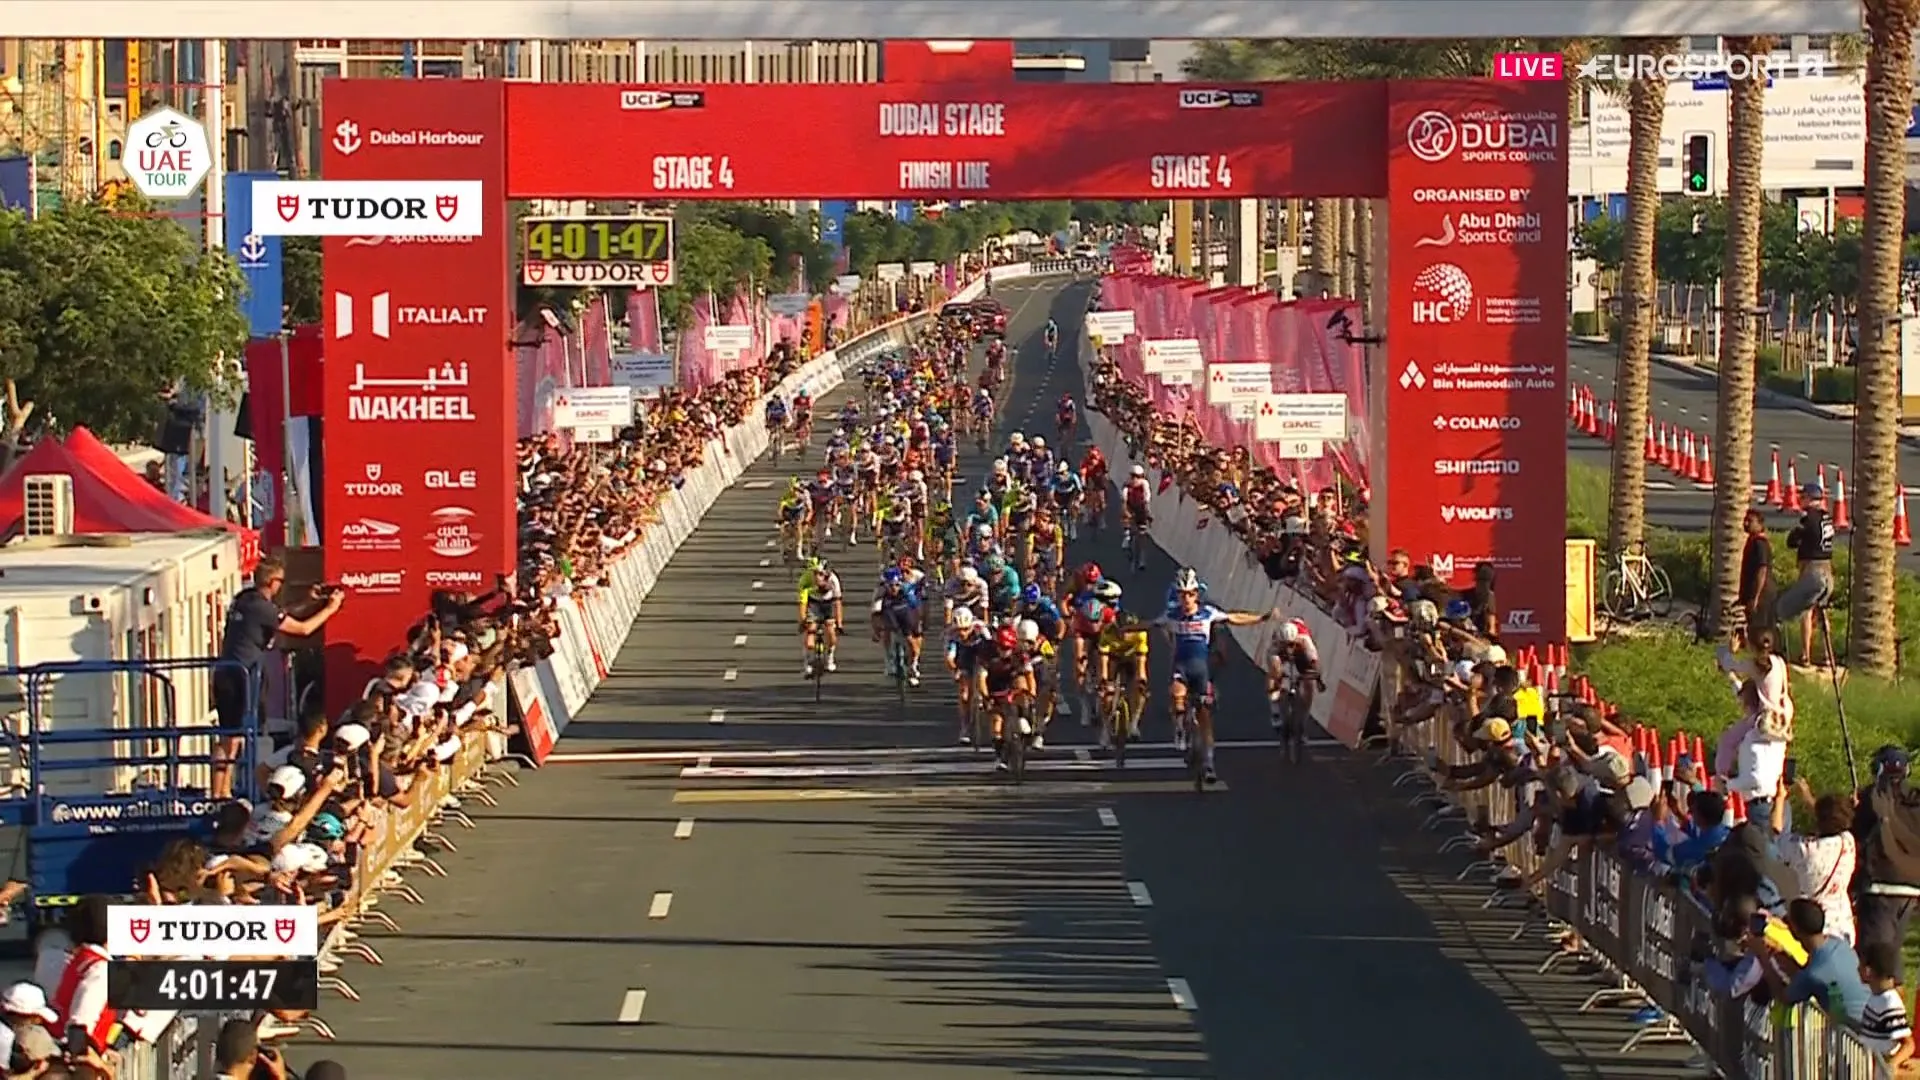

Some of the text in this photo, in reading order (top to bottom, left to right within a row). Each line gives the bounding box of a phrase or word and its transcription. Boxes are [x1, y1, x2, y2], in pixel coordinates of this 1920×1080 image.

[626, 94, 653, 106] UCI
[1184, 93, 1212, 105] UCI
[879, 103, 1005, 136] DUBAI STAGE
[370, 130, 484, 145] Dubai Harbour
[1461, 123, 1557, 148] DUBAI
[1462, 151, 1556, 161] SPORTS COUNCIL
[653, 156, 735, 190] STAGE 4
[900, 161, 990, 189] FINISH LINE
[1151, 155, 1232, 188] STAGE 4
[1413, 188, 1531, 202] ORGANISED BY
[1459, 212, 1541, 228] Abu Dhabi
[529, 222, 666, 260] 4:01:47
[1458, 229, 1541, 244] Sports Council
[552, 263, 645, 280] TUDOR
[398, 308, 487, 323] ITALIA.IT
[1412, 301, 1450, 323] IHC
[1433, 378, 1555, 389] Bin Hamoodah Auto
[348, 396, 476, 420] NAKHEEL
[1449, 417, 1521, 429] COLNAGO
[587, 429, 600, 439] 25
[1295, 443, 1308, 454] 10
[1434, 460, 1520, 474] SHIMANO
[344, 484, 403, 496] TUDOR
